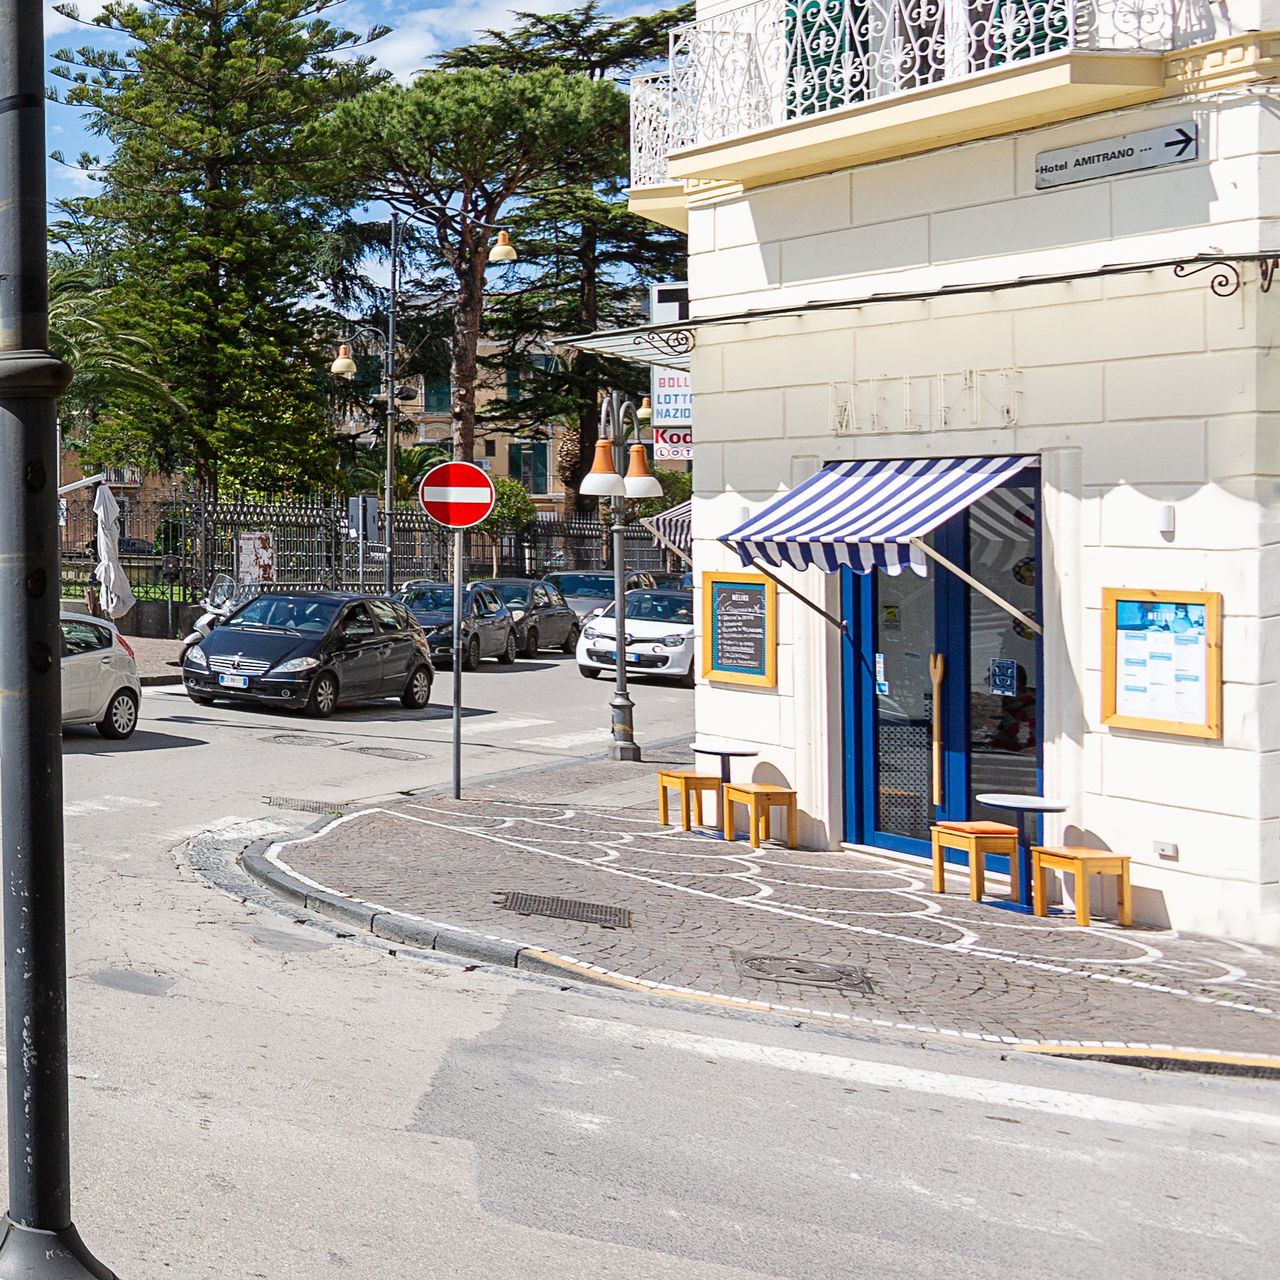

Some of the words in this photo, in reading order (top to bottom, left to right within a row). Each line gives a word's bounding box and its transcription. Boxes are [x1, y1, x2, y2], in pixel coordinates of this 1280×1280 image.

[1039, 160, 1068, 174] Hotel
[1073, 147, 1135, 168] AMITRANO
[654, 428, 693, 445] Kod
